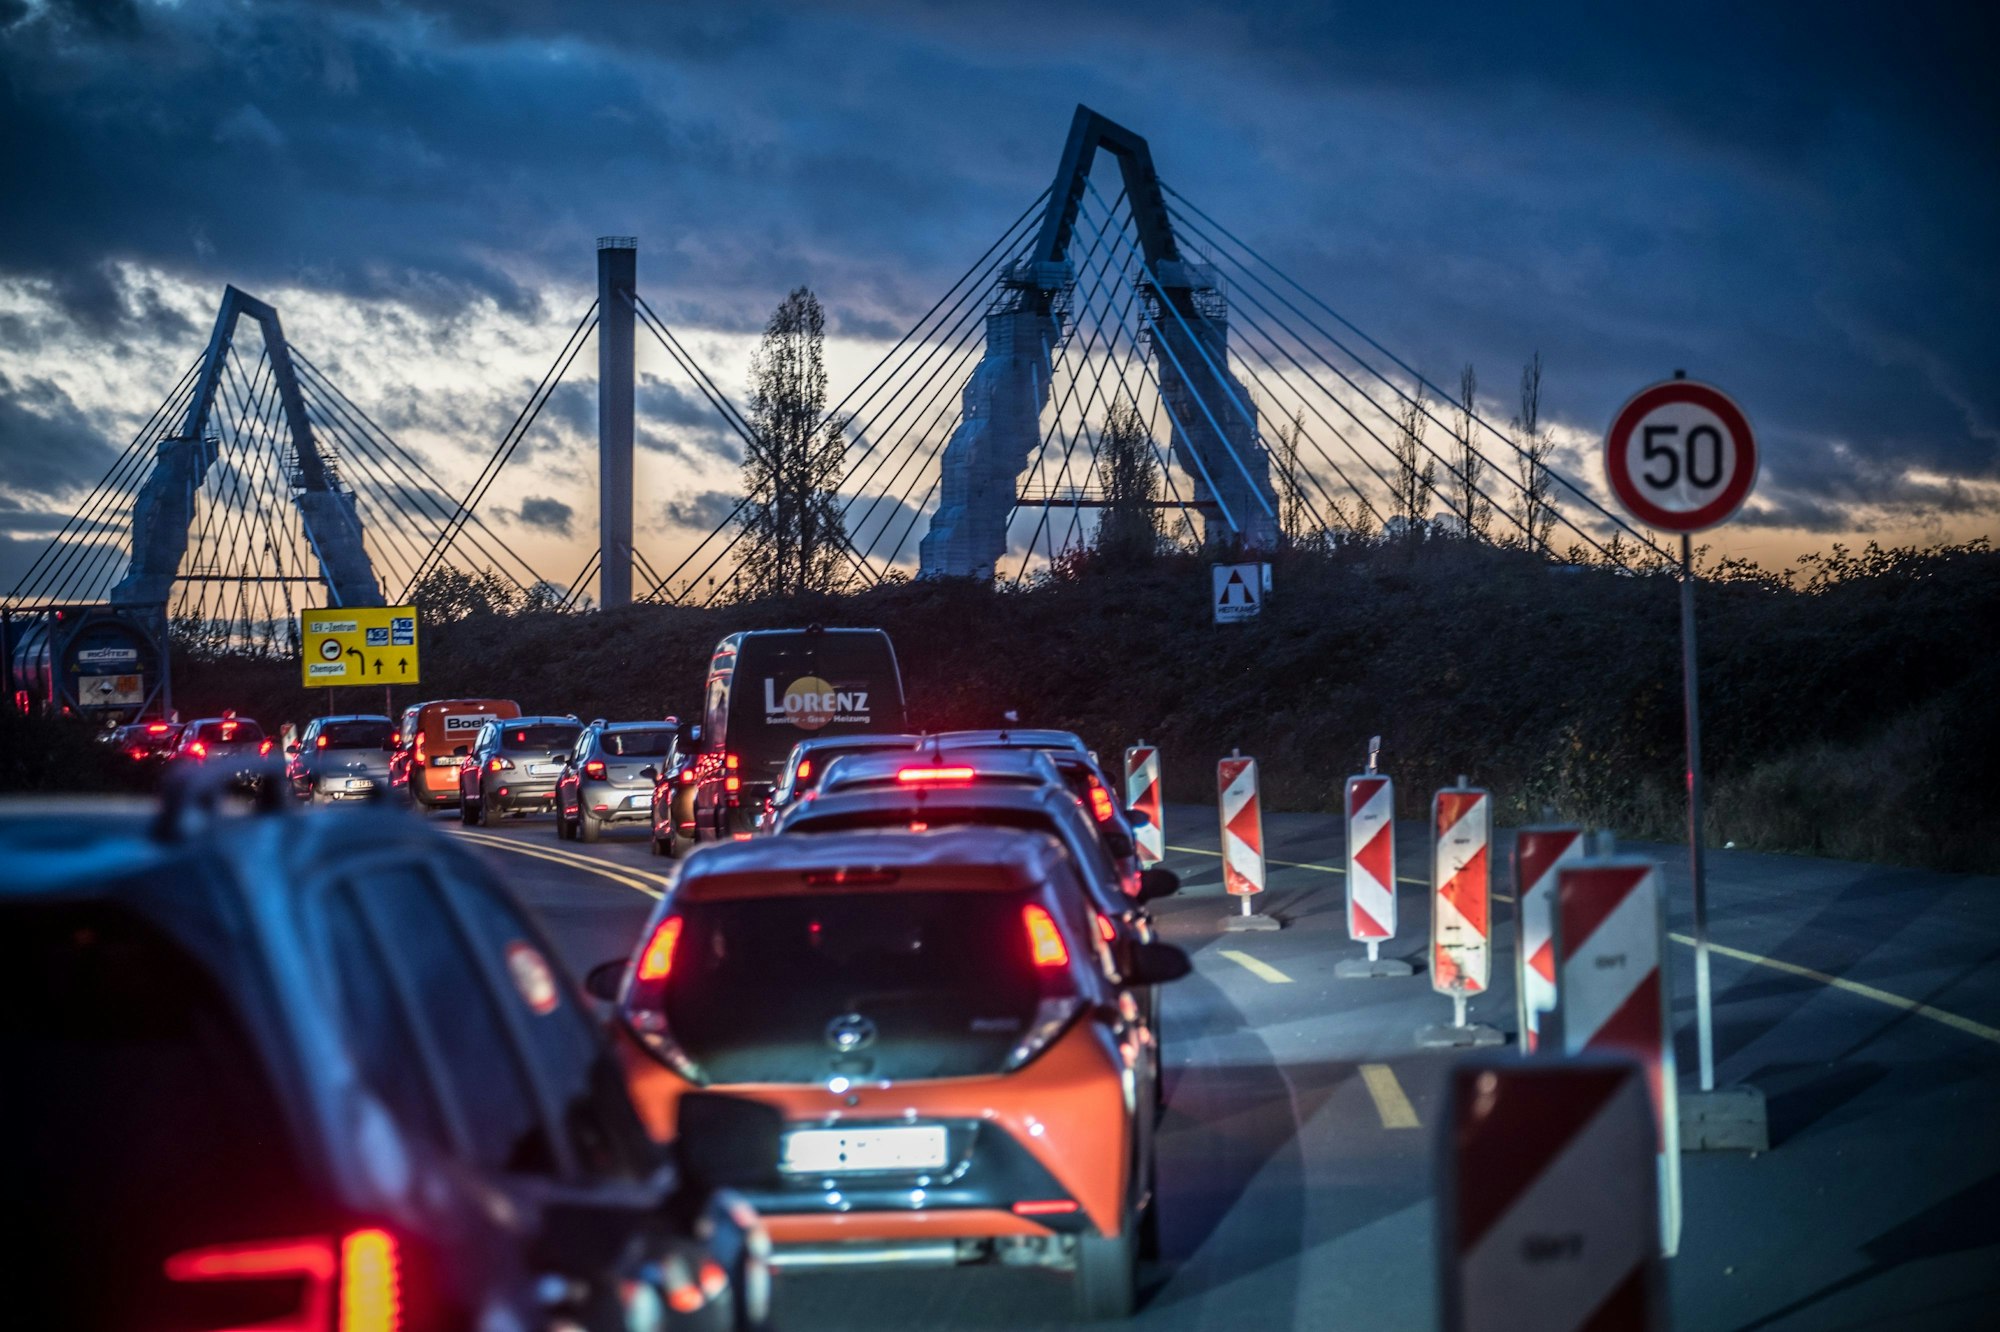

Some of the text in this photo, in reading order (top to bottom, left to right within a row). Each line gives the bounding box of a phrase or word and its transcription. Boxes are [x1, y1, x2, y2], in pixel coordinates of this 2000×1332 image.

[1643, 425, 1723, 490] 50
[87, 648, 129, 658] RICHTER
[310, 664, 344, 674] Chempark
[448, 718, 493, 728] Boel
[766, 716, 799, 724] Sanitär
[807, 715, 826, 723] Gas
[833, 715, 870, 723] Heizung
